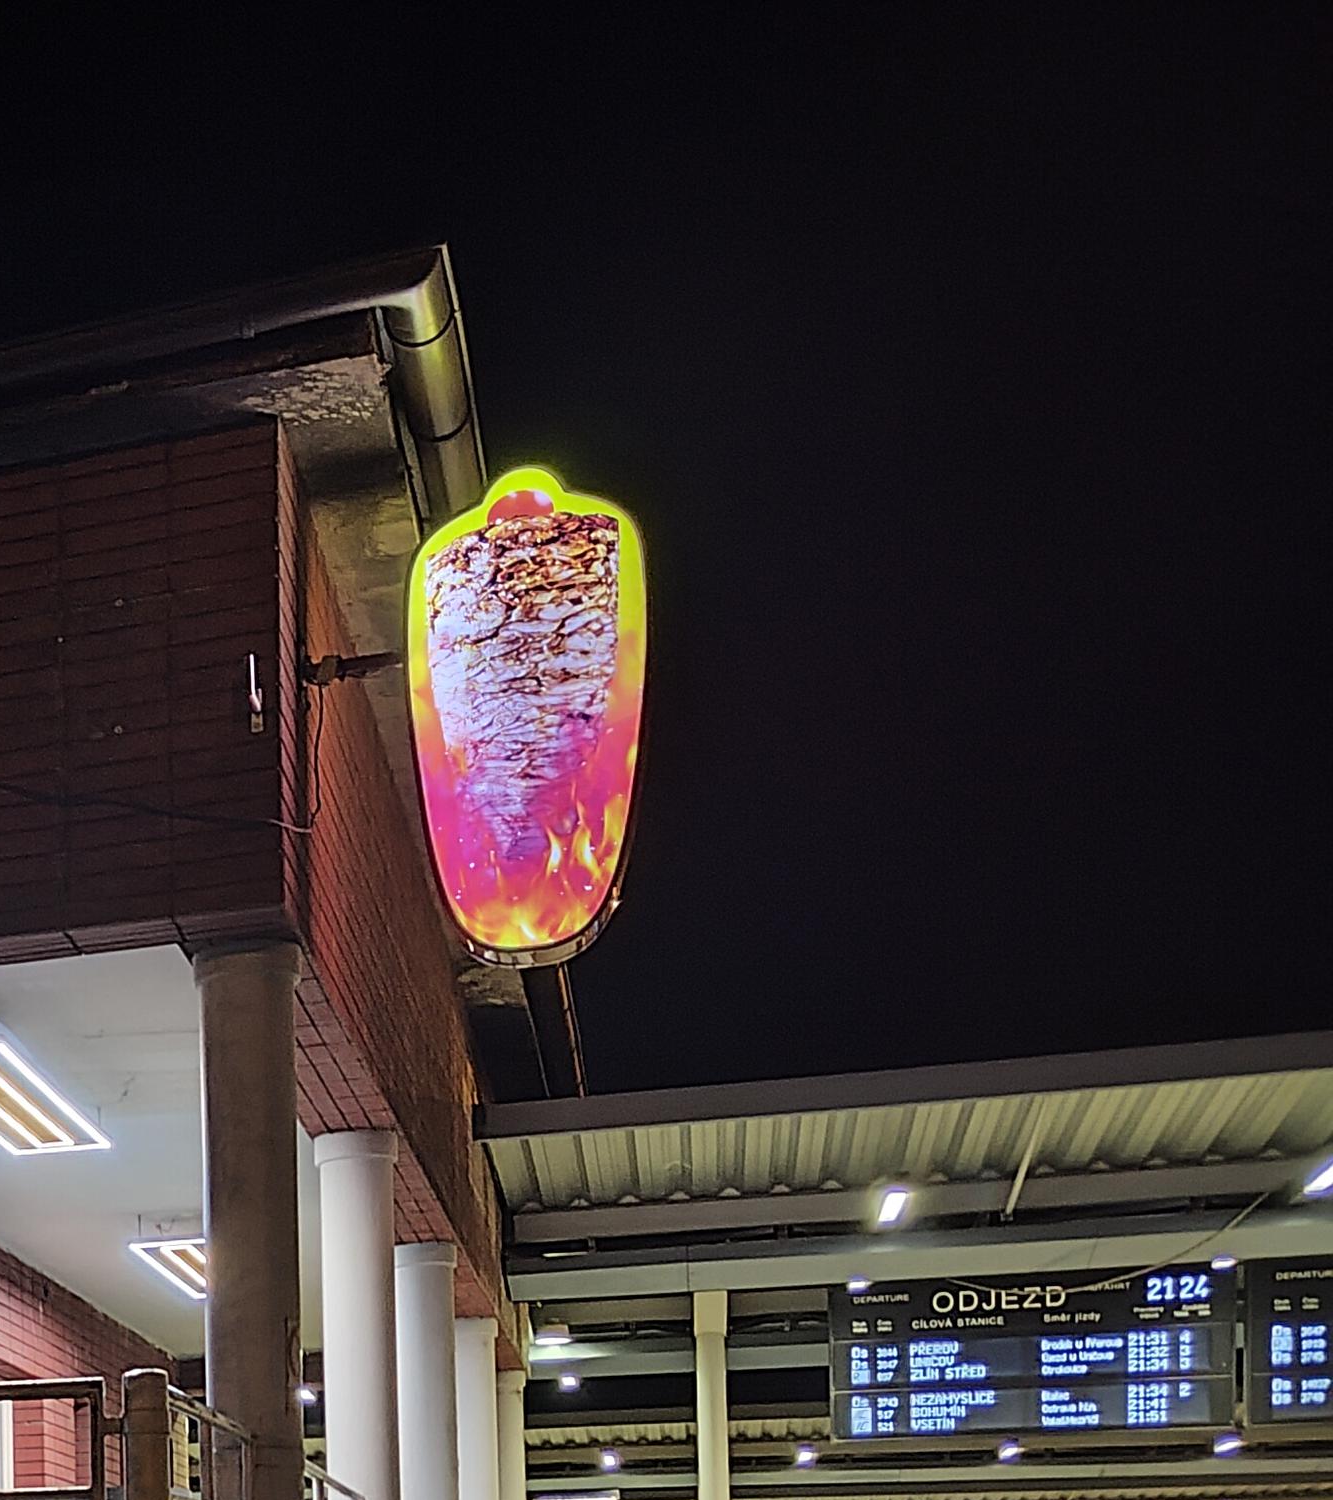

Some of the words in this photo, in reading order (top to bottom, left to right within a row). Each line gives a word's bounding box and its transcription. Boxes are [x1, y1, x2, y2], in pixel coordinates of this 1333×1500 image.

[1147, 1277, 1175, 1301] 21
[1180, 1275, 1209, 1298] 24
[853, 1294, 910, 1304] DEPARTURE
[933, 1285, 1066, 1313] ODJEZD
[912, 1317, 953, 1330] CÍLOVÁ
[957, 1316, 1005, 1327] STANICE
[910, 1342, 959, 1357] PŘEROV
[1128, 1332, 1168, 1346] 21:31
[1128, 1346, 1169, 1359] 21:32
[1180, 1345, 1191, 1357] 3
[910, 1369, 939, 1382] ZLÍN
[945, 1364, 986, 1380] STŘED
[1128, 1358, 1169, 1372] 21:34
[1180, 1358, 1191, 1370] 3
[910, 1390, 995, 1406] NEZAMYSLICE
[1128, 1384, 1169, 1397] 21:34
[1180, 1383, 1191, 1397] 2
[911, 1405, 966, 1418] BOHUMÍN
[1128, 1398, 1168, 1410] 21:41
[911, 1417, 956, 1431] VSETÍN
[1128, 1411, 1168, 1424] 21:51
